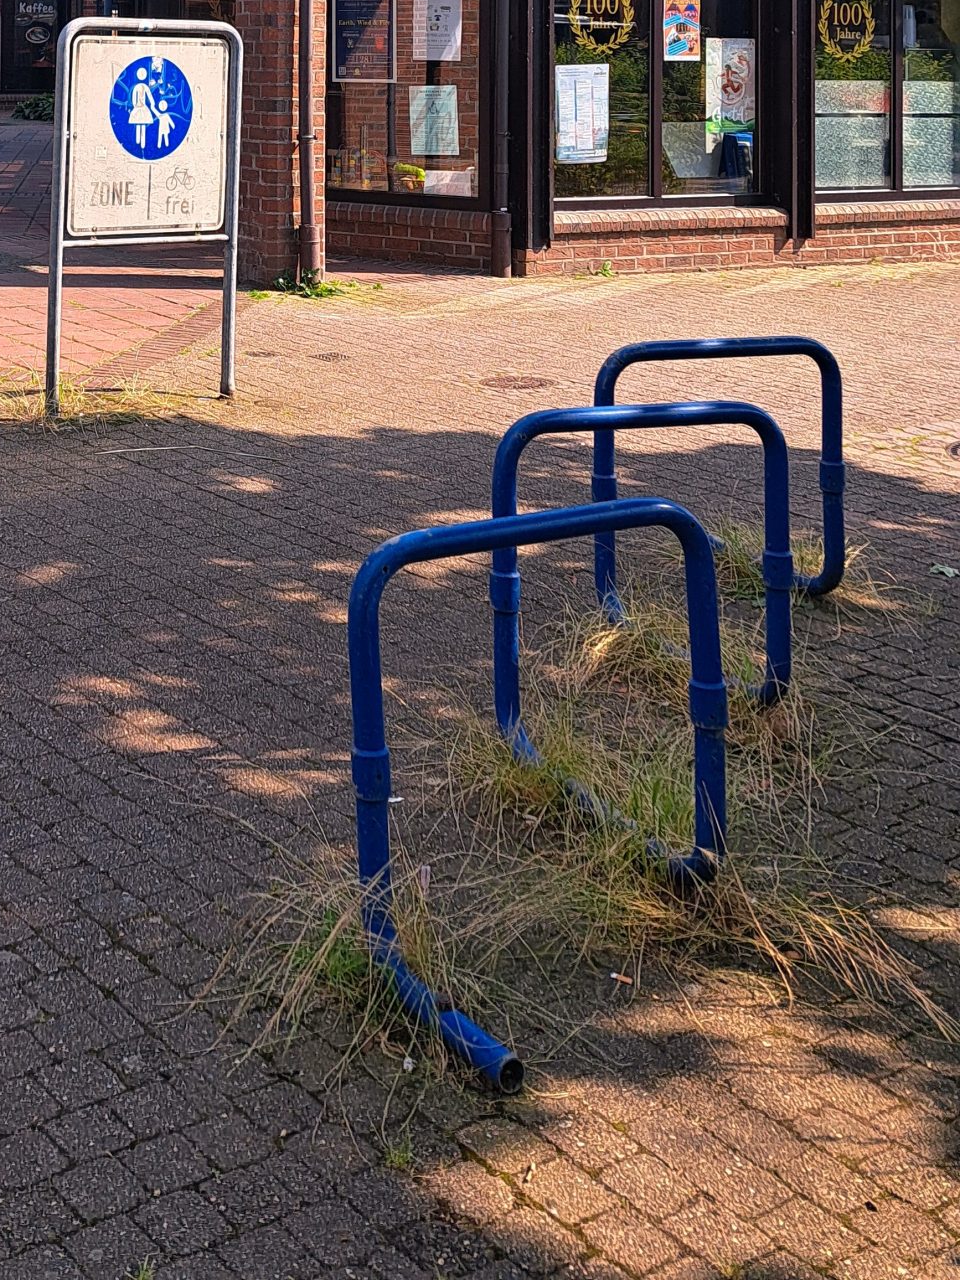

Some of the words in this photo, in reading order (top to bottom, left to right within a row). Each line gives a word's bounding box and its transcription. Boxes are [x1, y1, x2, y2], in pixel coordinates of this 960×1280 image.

[19, 1, 55, 13] Kaffee
[832, 1, 863, 26] 100
[587, 16, 619, 33] Jahre
[834, 27, 862, 42] Jahre
[89, 180, 135, 207] ZONE
[165, 195, 196, 215] frei
